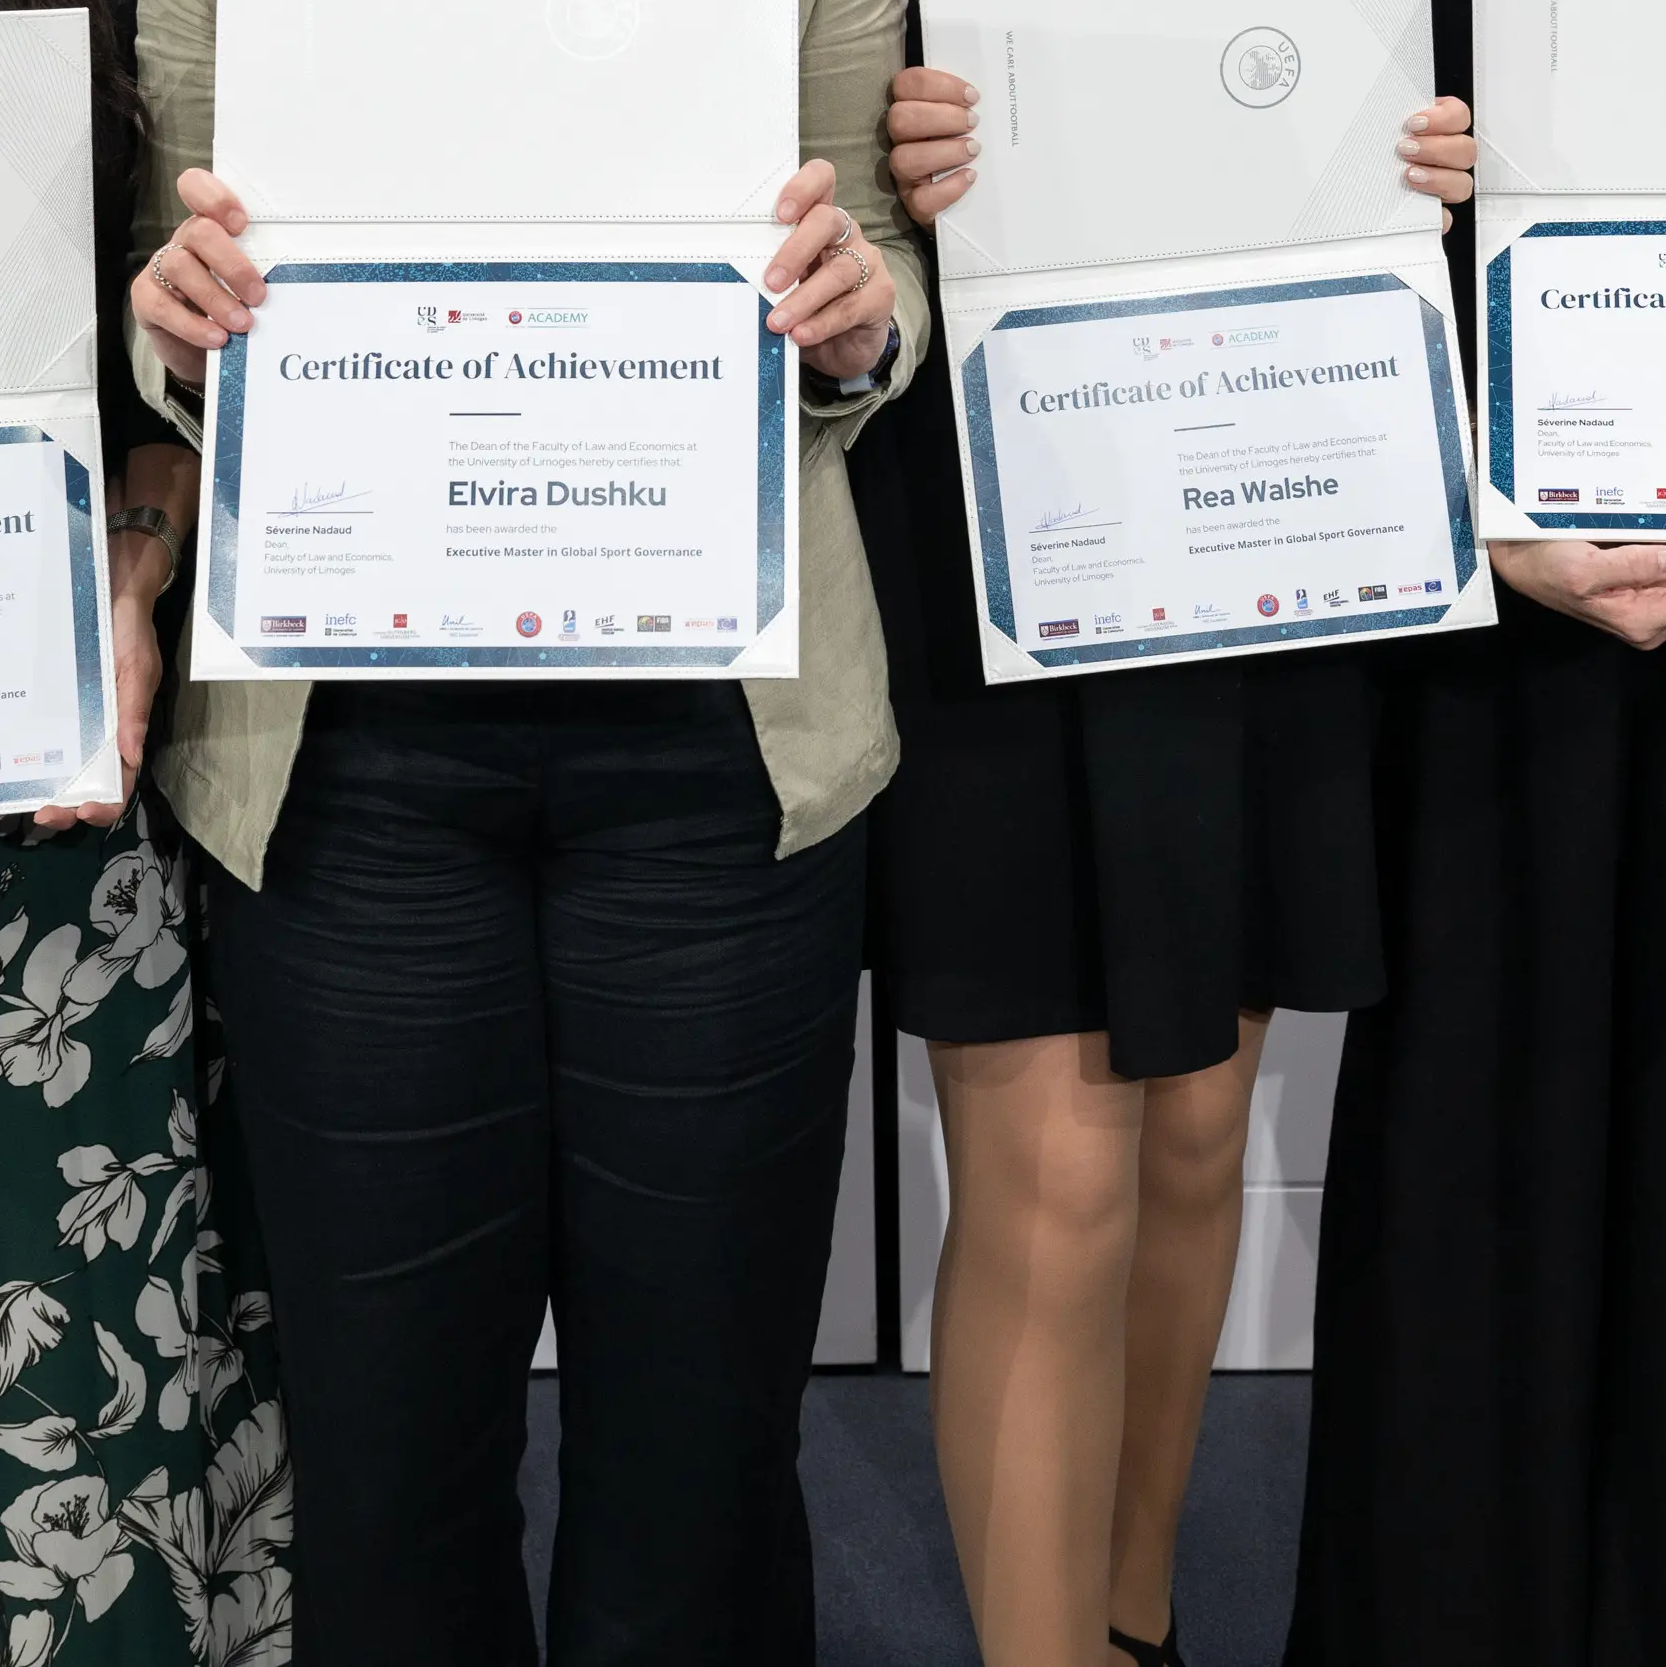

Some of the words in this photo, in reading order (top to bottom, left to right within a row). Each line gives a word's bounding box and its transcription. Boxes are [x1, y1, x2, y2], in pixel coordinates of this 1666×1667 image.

[1550, 0, 1558, 29] ABOUT
[1006, 30, 1013, 45] WE
[1006, 46, 1015, 69] CARE
[1278, 41, 1295, 88] UEFA
[1550, 30, 1558, 74] FOOTBALL
[1008, 72, 1017, 102] ABOUT
[1010, 103, 1019, 147] FOOTBALL
[527, 312, 588, 322] ACADEMY
[1228, 329, 1279, 343] ACADEMY
[279, 351, 453, 380] Certificate
[462, 351, 499, 379] of
[504, 351, 721, 379] Achievement
[1020, 380, 1171, 414] Certificate
[1178, 371, 1209, 397] of
[1215, 357, 1399, 394] Achievement
[1537, 418, 1577, 426] Séverine
[1579, 418, 1614, 426] Nadaud
[448, 479, 537, 506] Elvira
[546, 480, 665, 506] Dushku
[1182, 487, 1235, 510] Rea
[1240, 474, 1339, 504] Walshe
[265, 525, 310, 534] Séverine
[312, 525, 351, 534] Nadaud
[446, 524, 464, 533] has
[465, 523, 492, 533] been
[493, 523, 538, 533] awarded
[540, 523, 557, 533] the
[1185, 525, 1201, 534] has
[1202, 523, 1225, 532] been
[1226, 517, 1264, 530] awarded
[1265, 516, 1280, 526] the
[1030, 541, 1069, 552] Séverine
[1070, 536, 1105, 547] Nadaud
[1188, 542, 1235, 554] Executive
[1237, 539, 1272, 548] Master
[1273, 536, 1283, 545] in
[1285, 532, 1316, 543] Global
[1318, 530, 1345, 542] Sport
[1347, 525, 1404, 537] Governance
[446, 546, 500, 556] Executive
[504, 547, 544, 556] Master
[547, 546, 557, 556] in
[561, 546, 597, 556] Global
[600, 547, 630, 559] Sport
[634, 547, 702, 557] Governance
